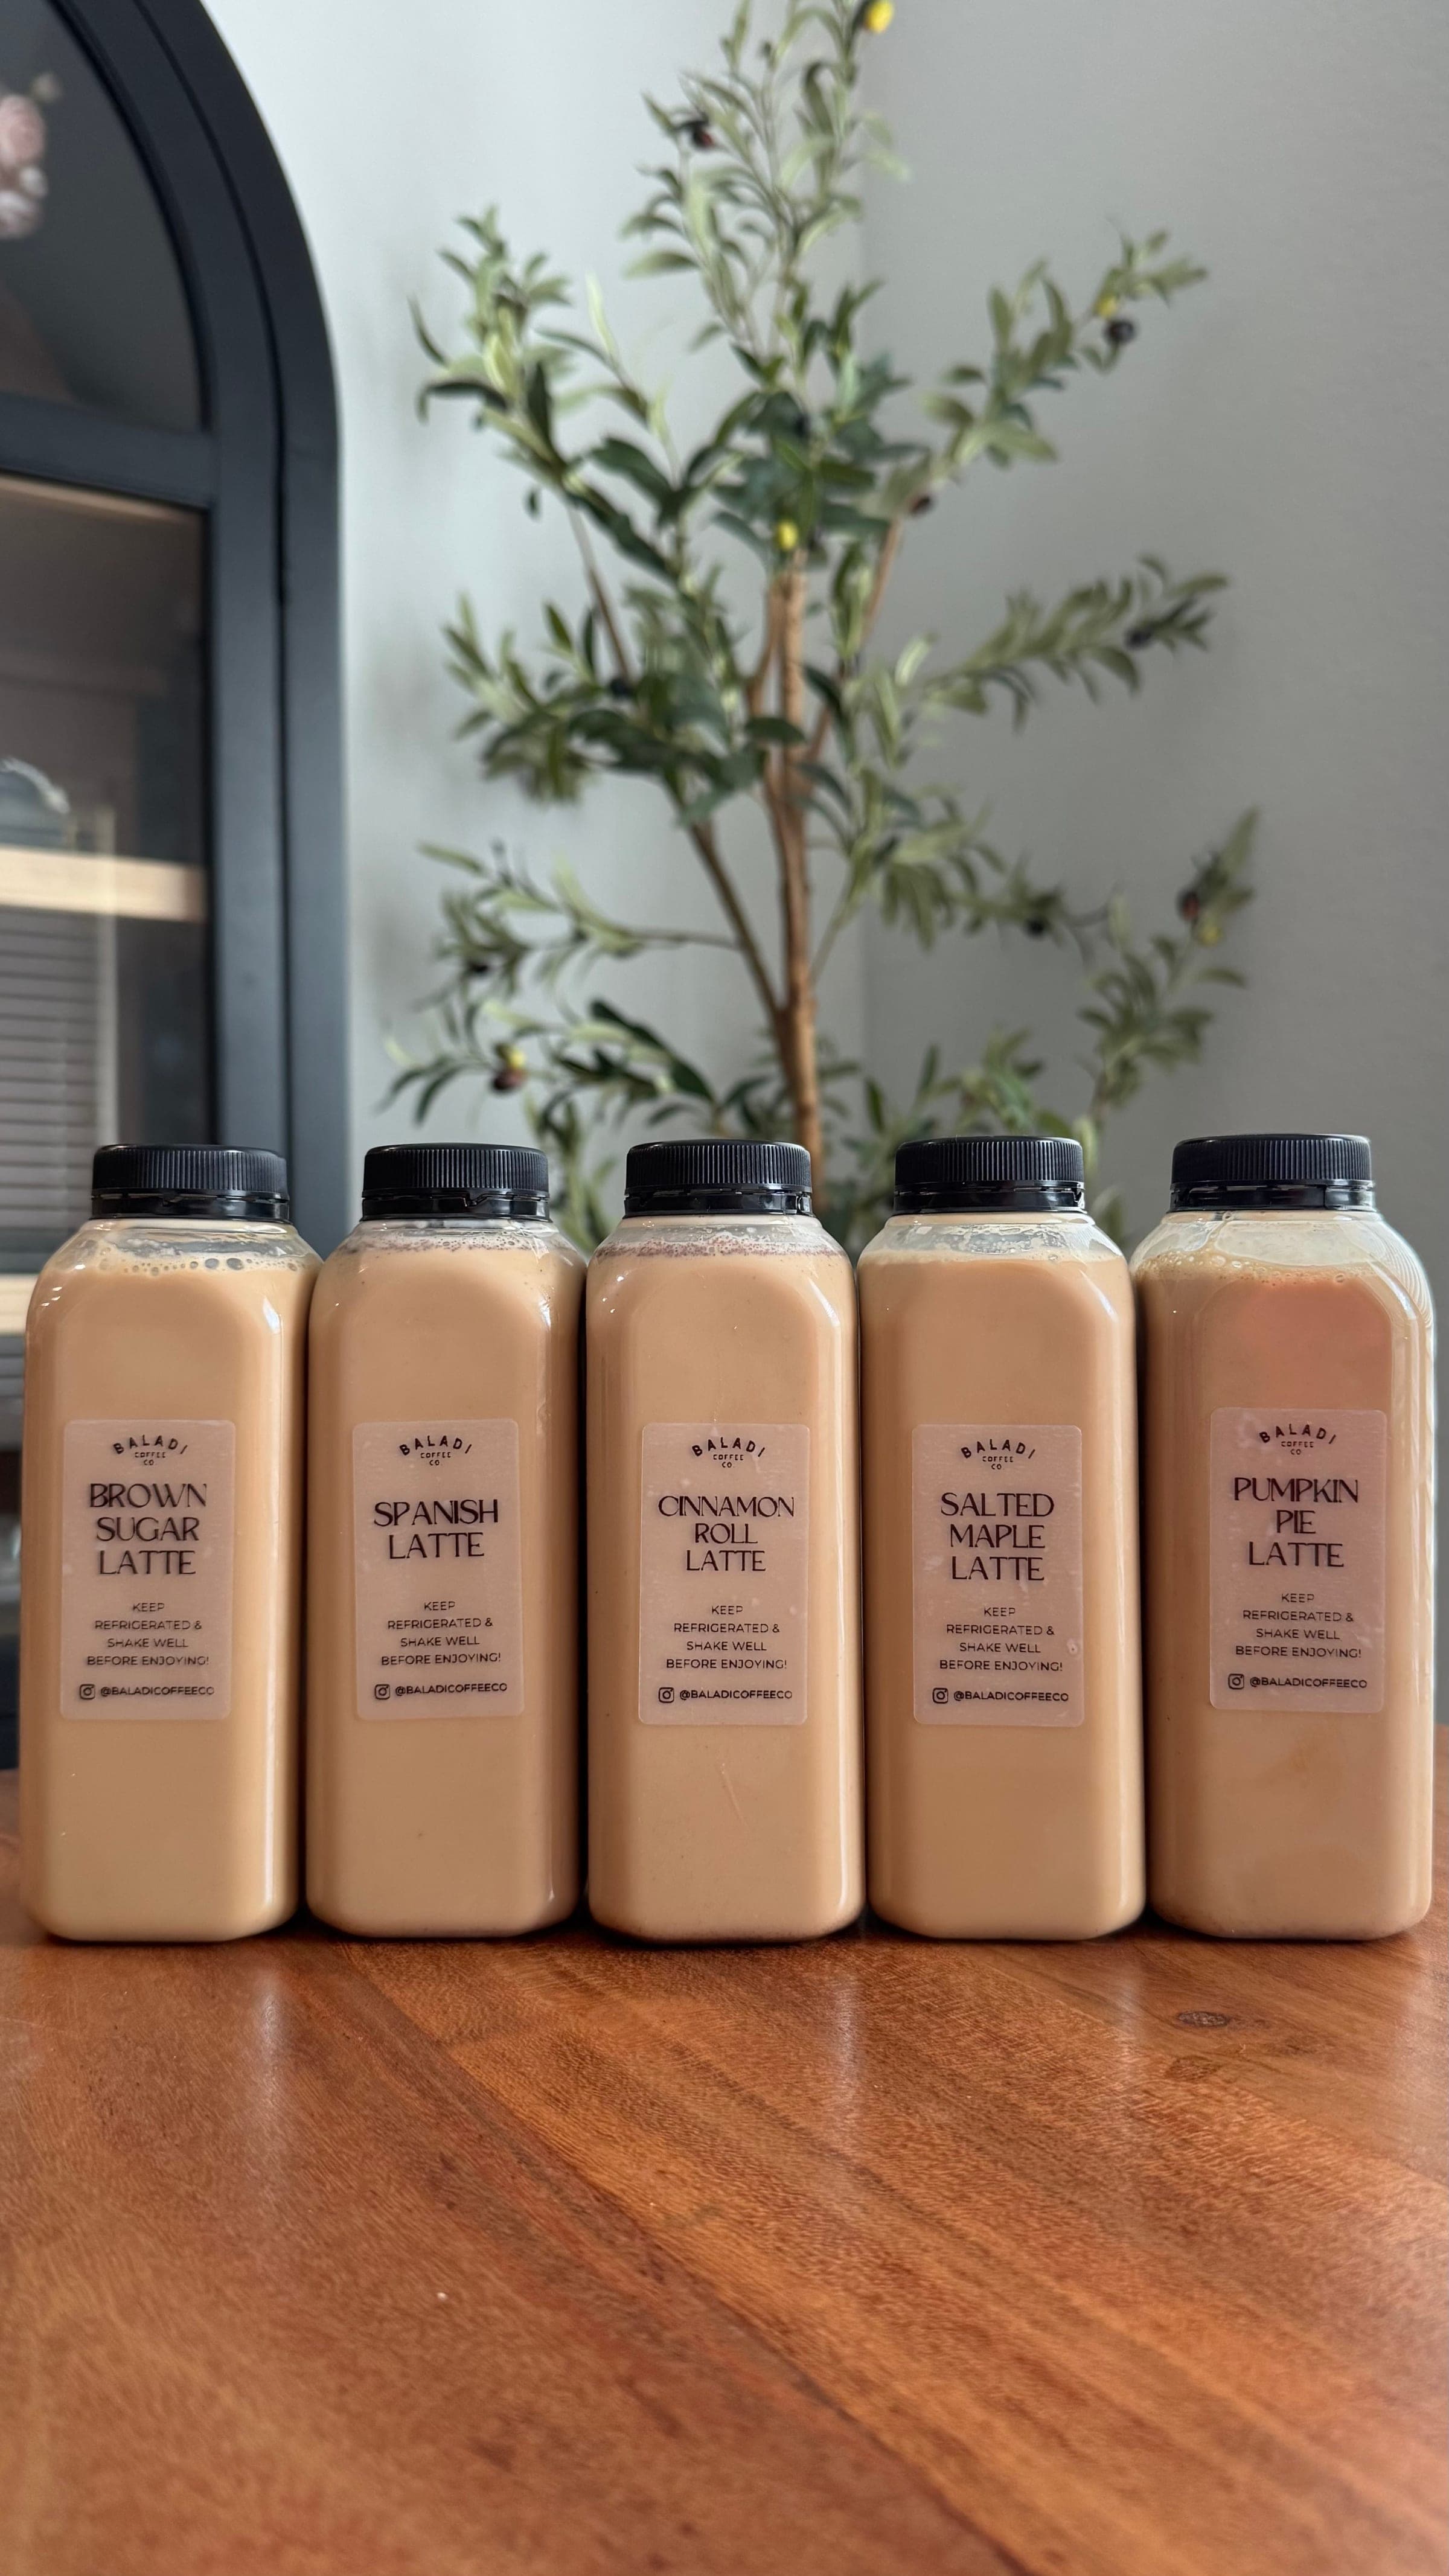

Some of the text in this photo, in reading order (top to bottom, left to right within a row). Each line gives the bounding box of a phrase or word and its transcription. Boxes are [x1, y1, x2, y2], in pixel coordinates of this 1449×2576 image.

[1259, 1424, 1336, 1445] BALADI
[113, 1434, 188, 1454] BALADI
[400, 1435, 472, 1456] BALADI
[692, 1437, 765, 1457] BALADI
[961, 1439, 1035, 1459] BALADI
[90, 1483, 206, 1507] BROWN
[1234, 1477, 1358, 1503] PUMPKIN
[658, 1496, 794, 1517] CINNAMON
[941, 1492, 1054, 1517] SALTED
[374, 1499, 498, 1527] SPANISH
[1276, 1510, 1316, 1533] PIE
[97, 1517, 199, 1541] SUGAR
[696, 1523, 758, 1544] ROLL
[950, 1525, 1045, 1548] MAPLE
[389, 1532, 484, 1559] LATTE
[686, 1550, 766, 1571] LATTE
[1249, 1542, 1344, 1567] LATTE
[99, 1551, 196, 1574] LATTE
[952, 1556, 1044, 1580] LATTE
[1281, 1593, 1314, 1602] KEEP
[424, 1602, 456, 1611] KEEP
[712, 1606, 743, 1614] KEEP
[984, 1607, 1016, 1616] KEEP
[1243, 1610, 1354, 1622] REFRIGERATED &
[95, 1620, 202, 1630] REFRIGERATED &
[388, 1618, 493, 1630] REFRIGERATED &
[674, 1623, 779, 1632] REFRIGERATED &
[947, 1625, 1055, 1635] REFRIGERATED &
[1256, 1629, 1340, 1640] SHAKE WELL
[107, 1638, 188, 1648] SHAKE WELL
[400, 1636, 480, 1647] SHAKE WELL
[686, 1641, 767, 1651] SHAKE WELL
[960, 1643, 1041, 1653] SHAKE WELL
[1236, 1646, 1361, 1658] BEFORE ENJOYING!
[87, 1656, 209, 1665] BEFORE ENJOYING!
[381, 1652, 501, 1666] BEFORE ENJOYING!
[667, 1660, 787, 1669] BEFORE ENJOYING!
[939, 1660, 1063, 1671] BEFORE ENJOYING!
[1250, 1677, 1367, 1688] @BALADICOFFEECO
[101, 1686, 214, 1696] @BALADICOFFEECO
[395, 1683, 507, 1696] @BALADICOFFEECO
[679, 1690, 792, 1700] @BALADICOFFEECO
[953, 1690, 1069, 1702] @BALADICOFFEECO
